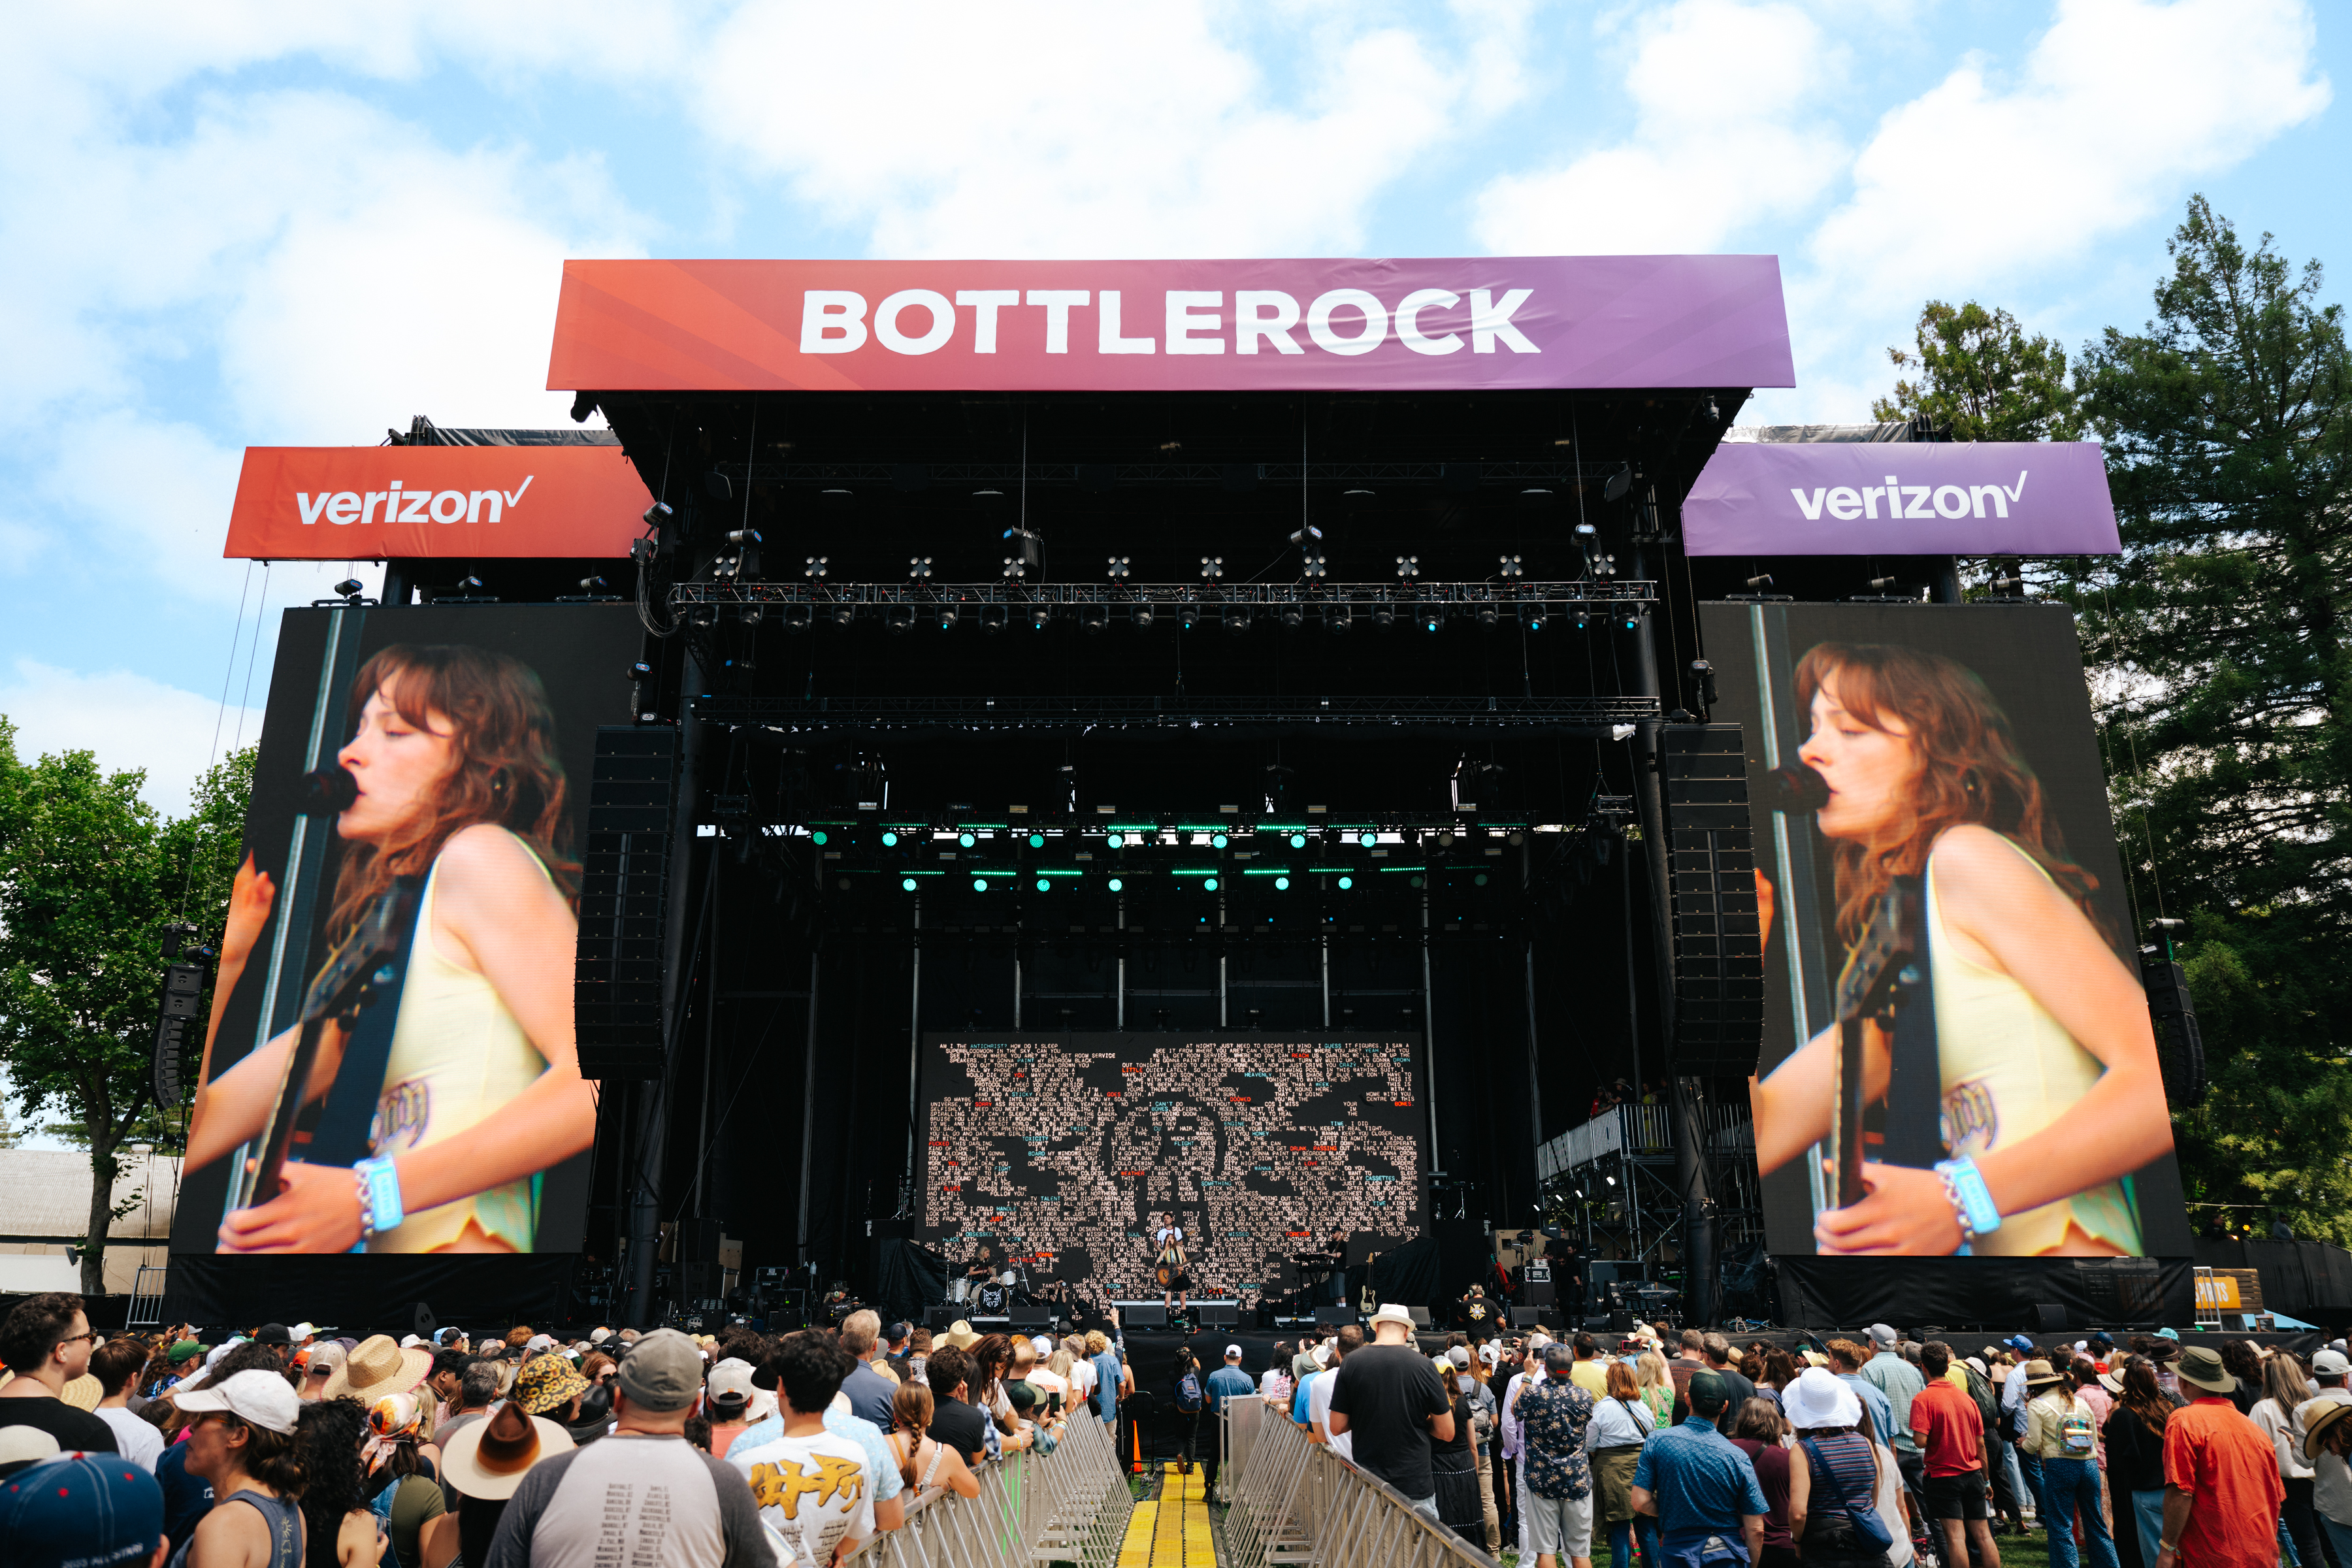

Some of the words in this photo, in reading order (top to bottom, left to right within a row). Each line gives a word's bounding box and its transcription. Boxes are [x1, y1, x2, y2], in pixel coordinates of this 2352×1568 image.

[800, 287, 1541, 355] BOTTLEROCK
[297, 481, 502, 525] verizon
[1791, 476, 2008, 520] verizon
[2195, 1282, 2229, 1302] SPIRTS
[1037, 1383, 1058, 1392] URON
